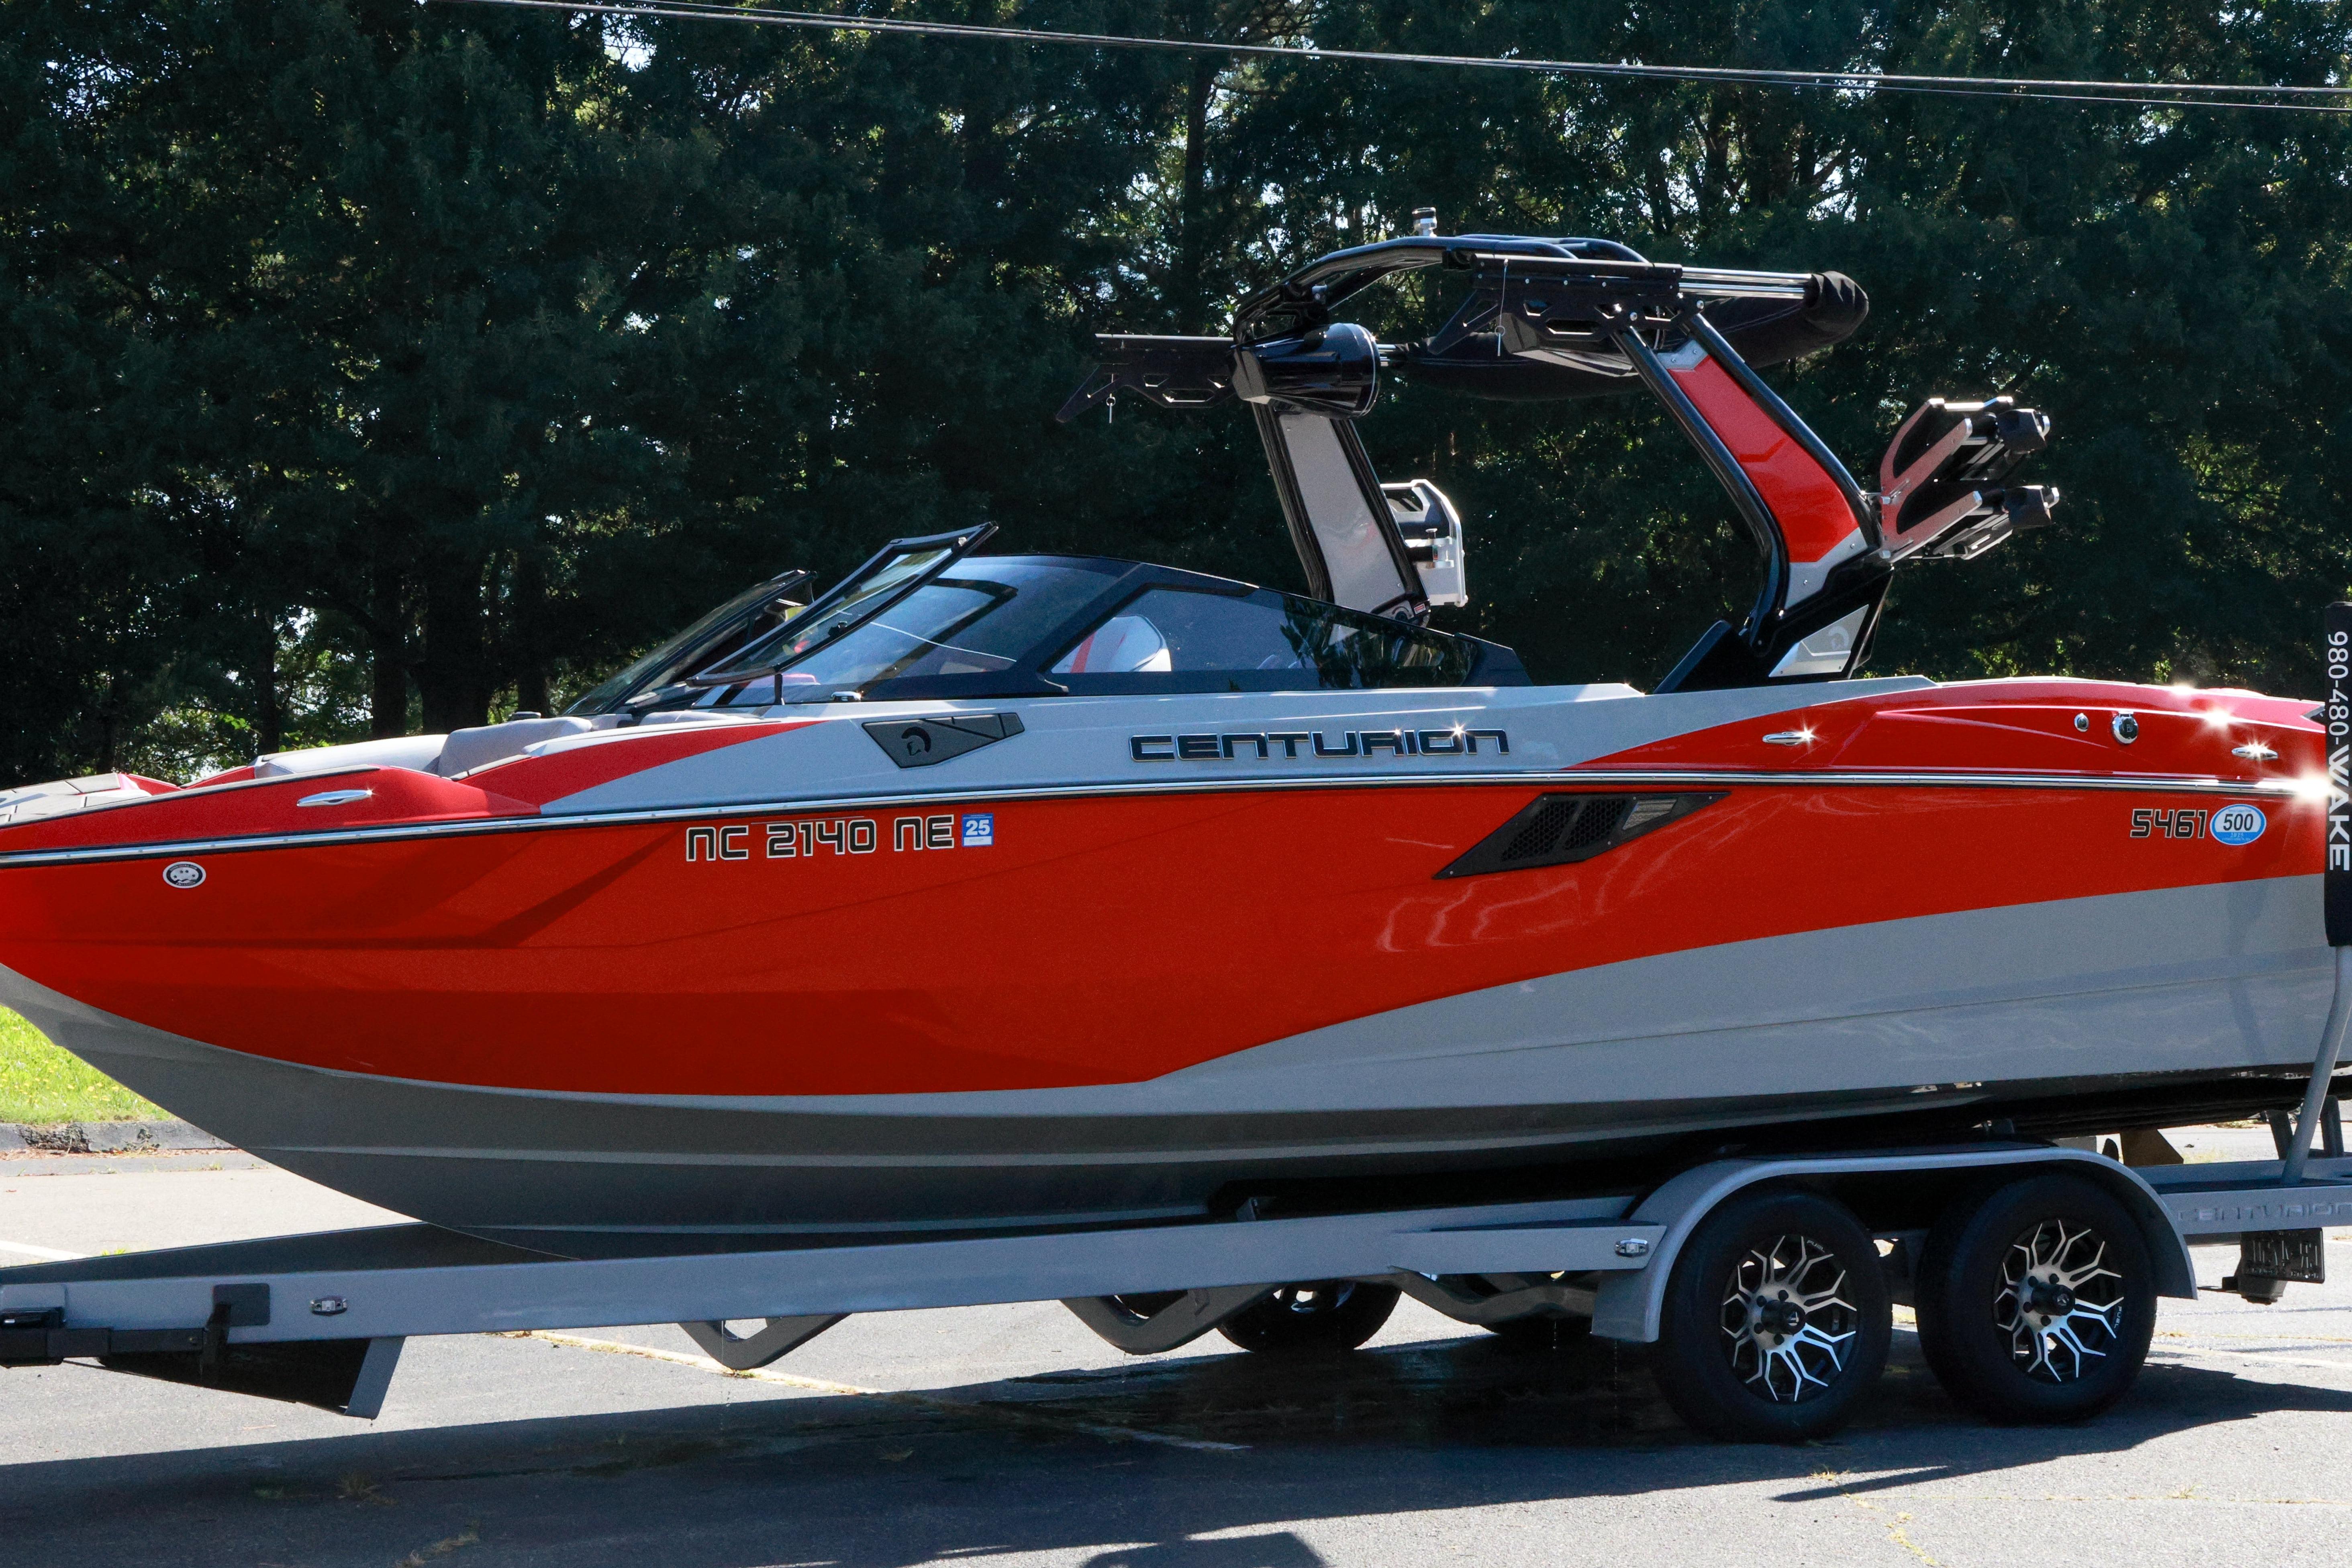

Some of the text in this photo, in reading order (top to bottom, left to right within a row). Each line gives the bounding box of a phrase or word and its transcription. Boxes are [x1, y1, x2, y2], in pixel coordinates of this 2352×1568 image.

[1129, 728, 1509, 762] CENTURION
[2328, 631, 2350, 870] 980-480-WAKE
[966, 819, 990, 836] 25
[2223, 813, 2253, 831] 500
[686, 814, 955, 862] NC 2140 NE
[2114, 1306, 2122, 1329] FUEL
